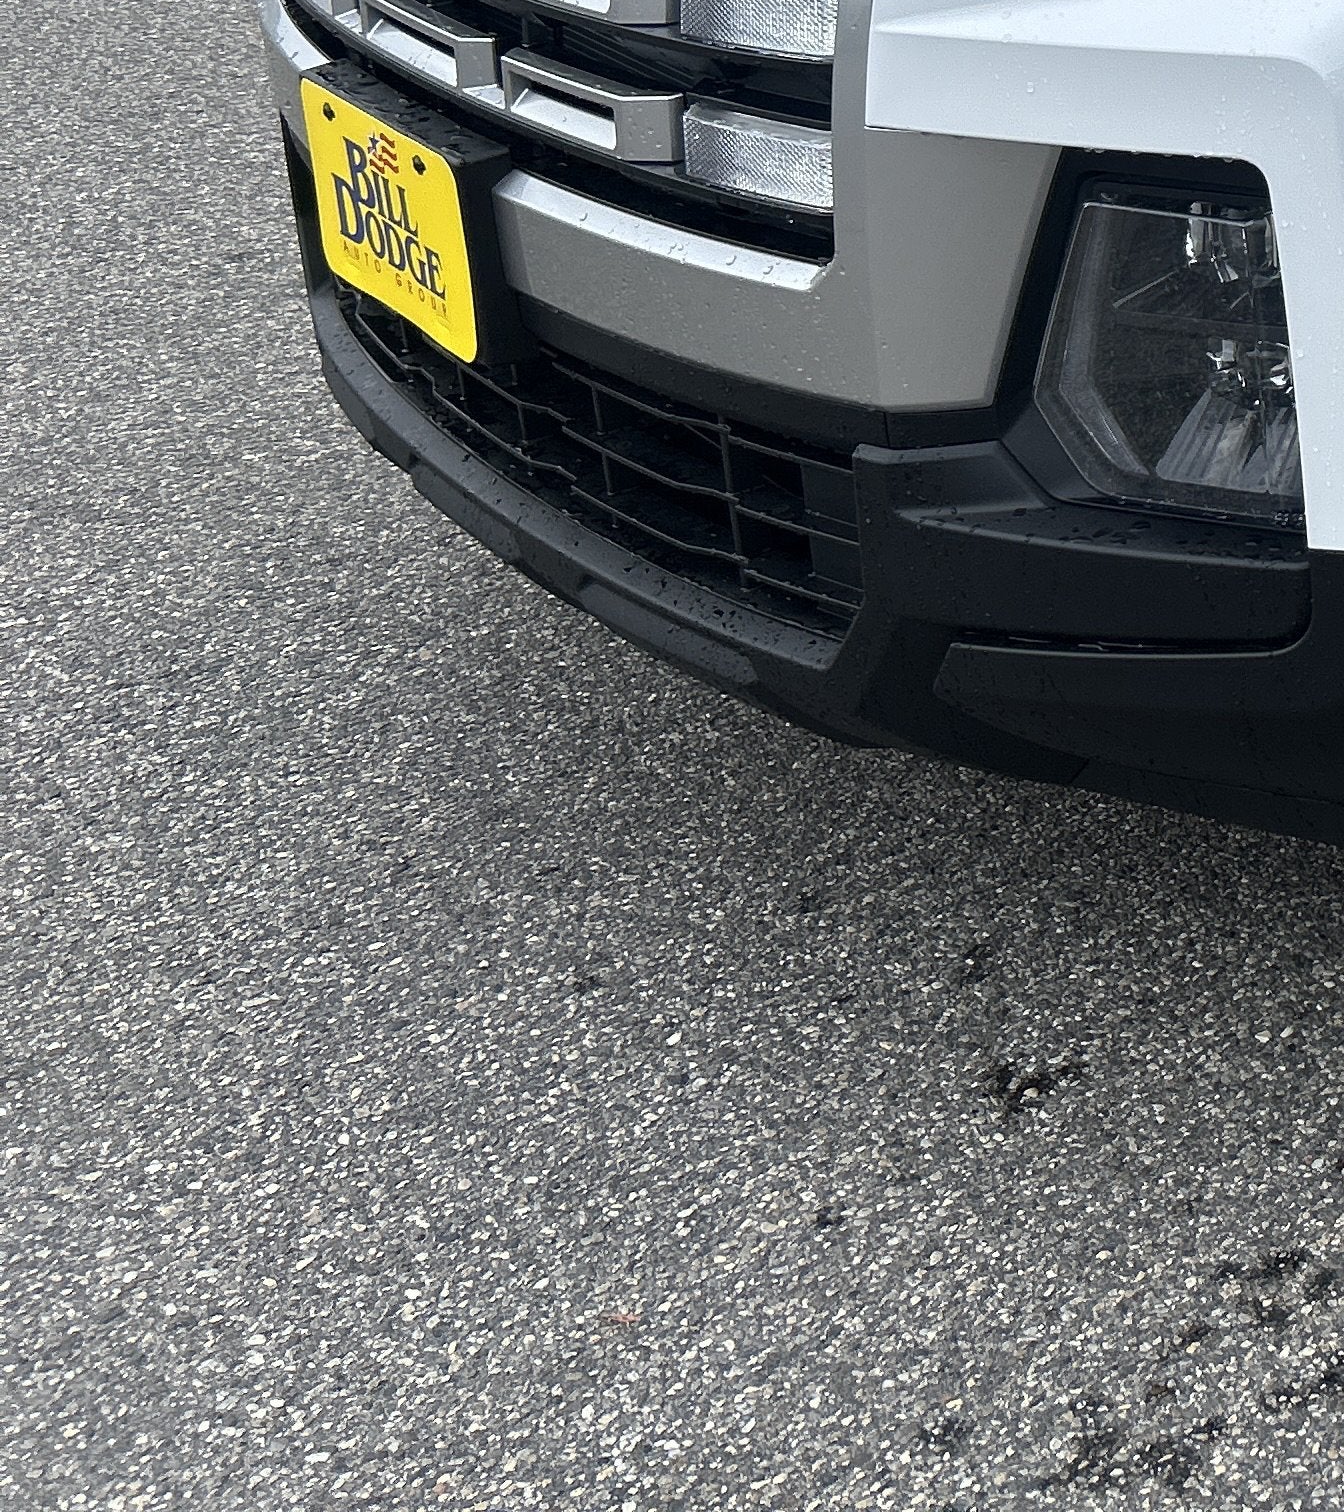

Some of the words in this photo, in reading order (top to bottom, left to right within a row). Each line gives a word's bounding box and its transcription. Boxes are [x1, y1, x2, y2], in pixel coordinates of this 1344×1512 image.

[331, 172, 446, 301] DODGE
[342, 135, 419, 238] BILL
[342, 240, 382, 274] AUTO
[394, 272, 447, 318] GROUP
